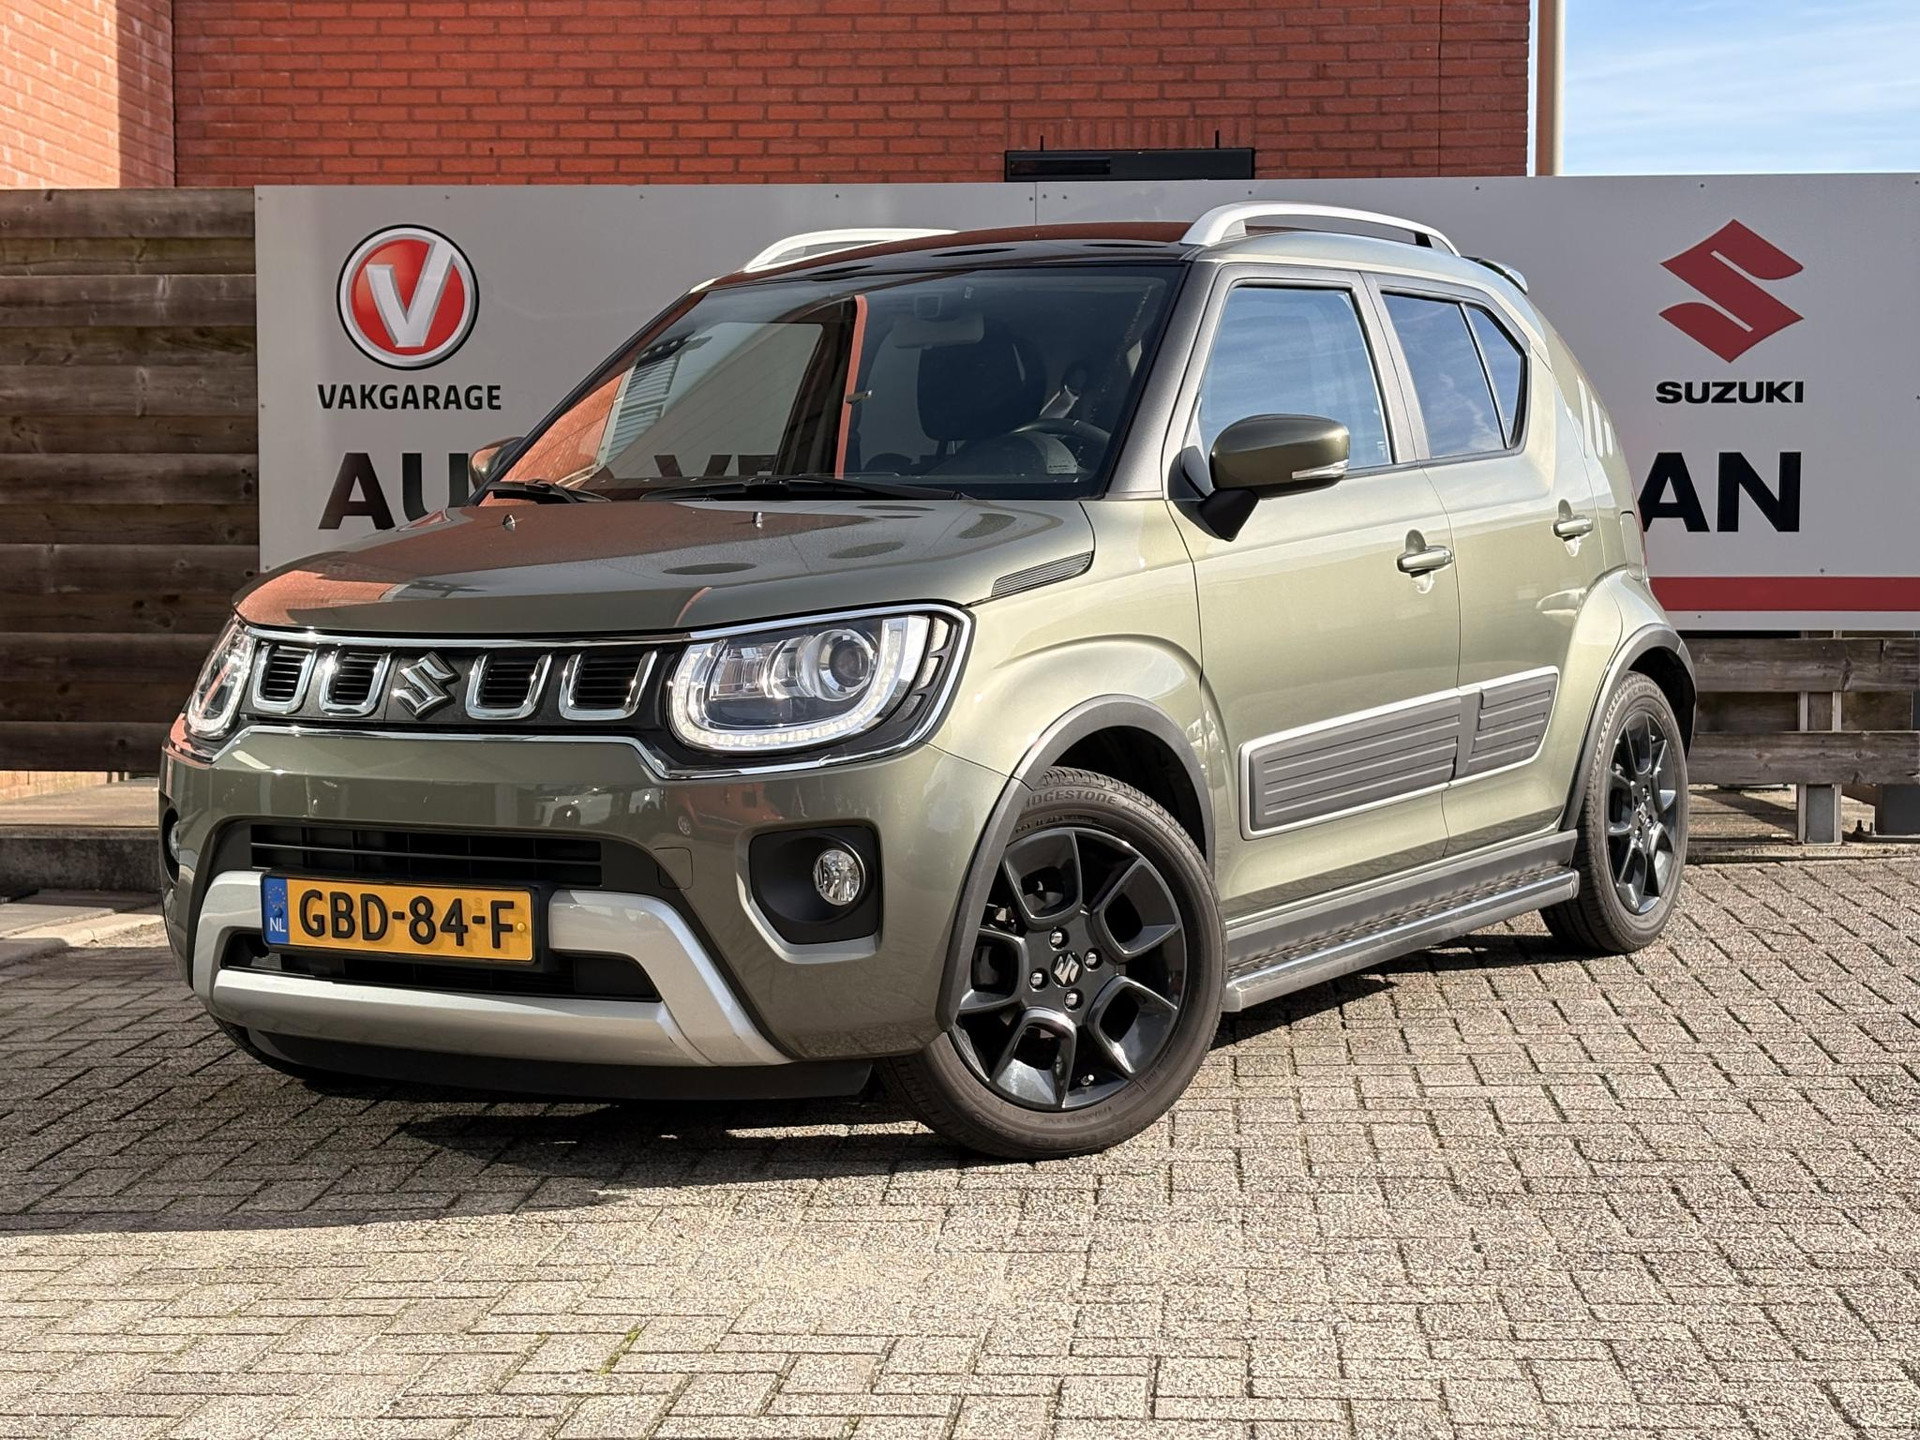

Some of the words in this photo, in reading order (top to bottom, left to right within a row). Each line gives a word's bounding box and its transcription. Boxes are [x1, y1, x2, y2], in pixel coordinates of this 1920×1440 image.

[317, 383, 502, 411] VAKGARAGE
[1655, 380, 1805, 404] SUZUKI
[317, 452, 470, 531] AU
[1637, 451, 1802, 533] AN
[1026, 789, 1118, 806] IDGESTONE
[269, 916, 287, 933] NL
[299, 888, 516, 949] GBD-84-F
